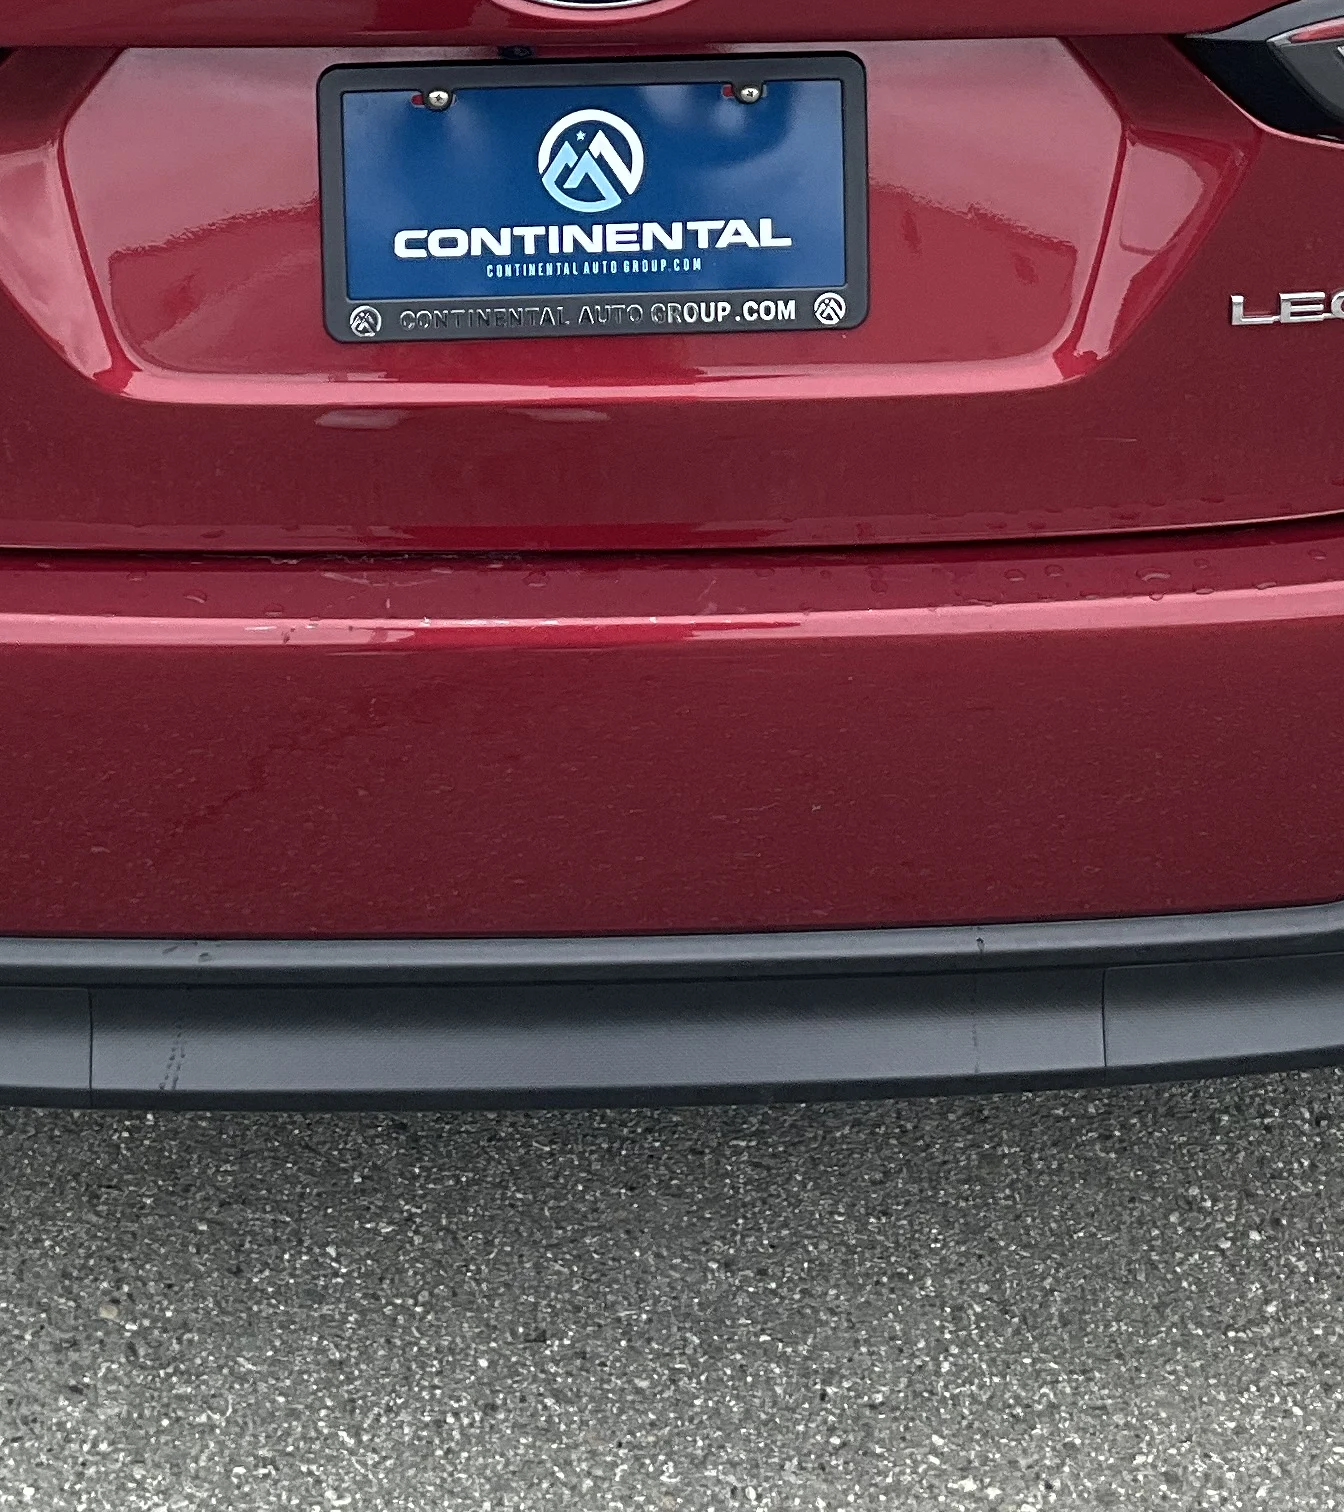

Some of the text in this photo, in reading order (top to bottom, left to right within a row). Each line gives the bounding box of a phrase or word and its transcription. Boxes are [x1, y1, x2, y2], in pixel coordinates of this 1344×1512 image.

[393, 218, 793, 258] CONTINENTAL
[486, 262, 578, 278] CONTINENTAL
[583, 260, 617, 275] AUTO
[399, 306, 570, 331] CONTINENTAL
[578, 303, 643, 326] AUTO
